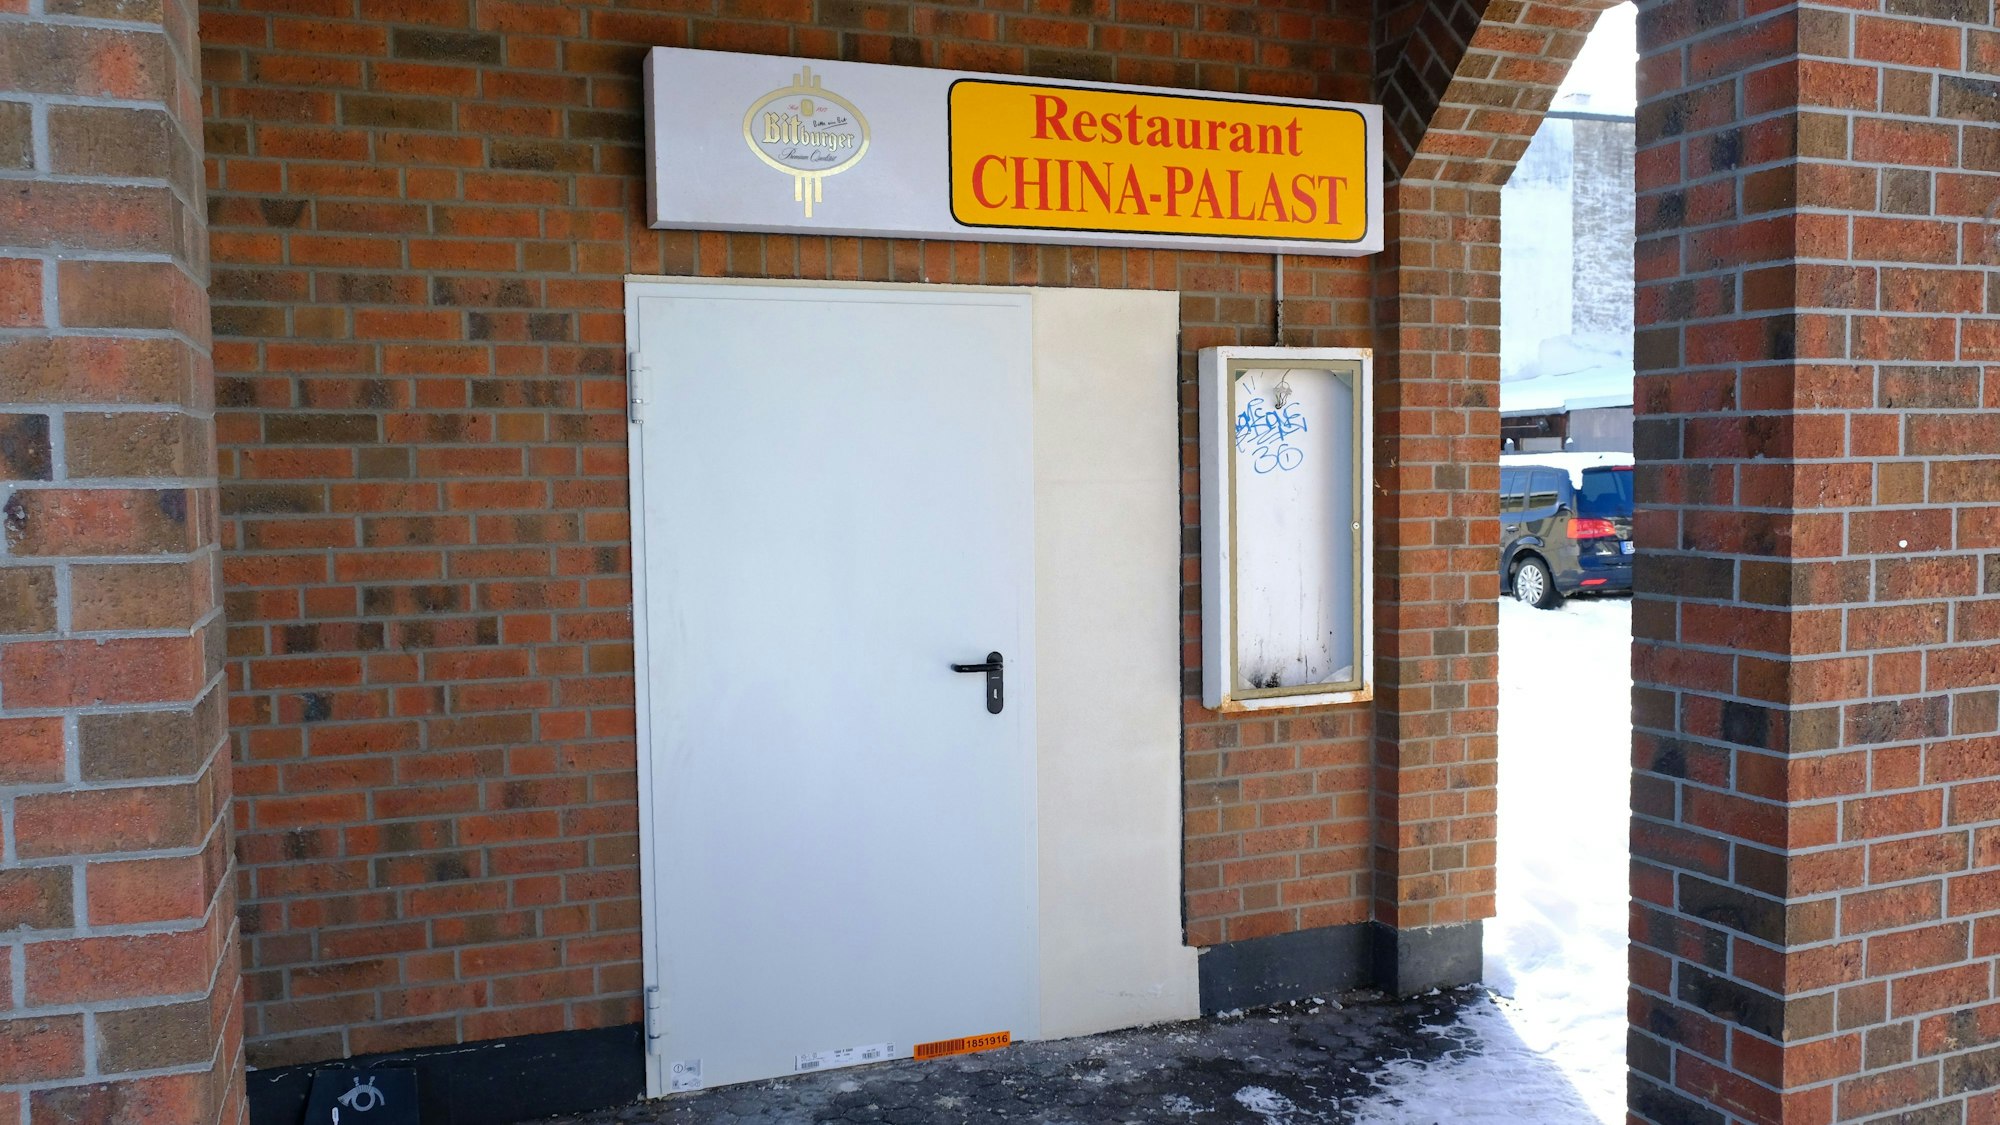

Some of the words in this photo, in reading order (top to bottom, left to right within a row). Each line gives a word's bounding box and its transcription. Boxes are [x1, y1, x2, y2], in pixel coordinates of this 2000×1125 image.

[762, 112, 854, 152] Bitburger
[1031, 94, 1303, 157] Restaurant
[971, 154, 1348, 225] CHINA-PALAST
[966, 1034, 1008, 1049] 1851916
